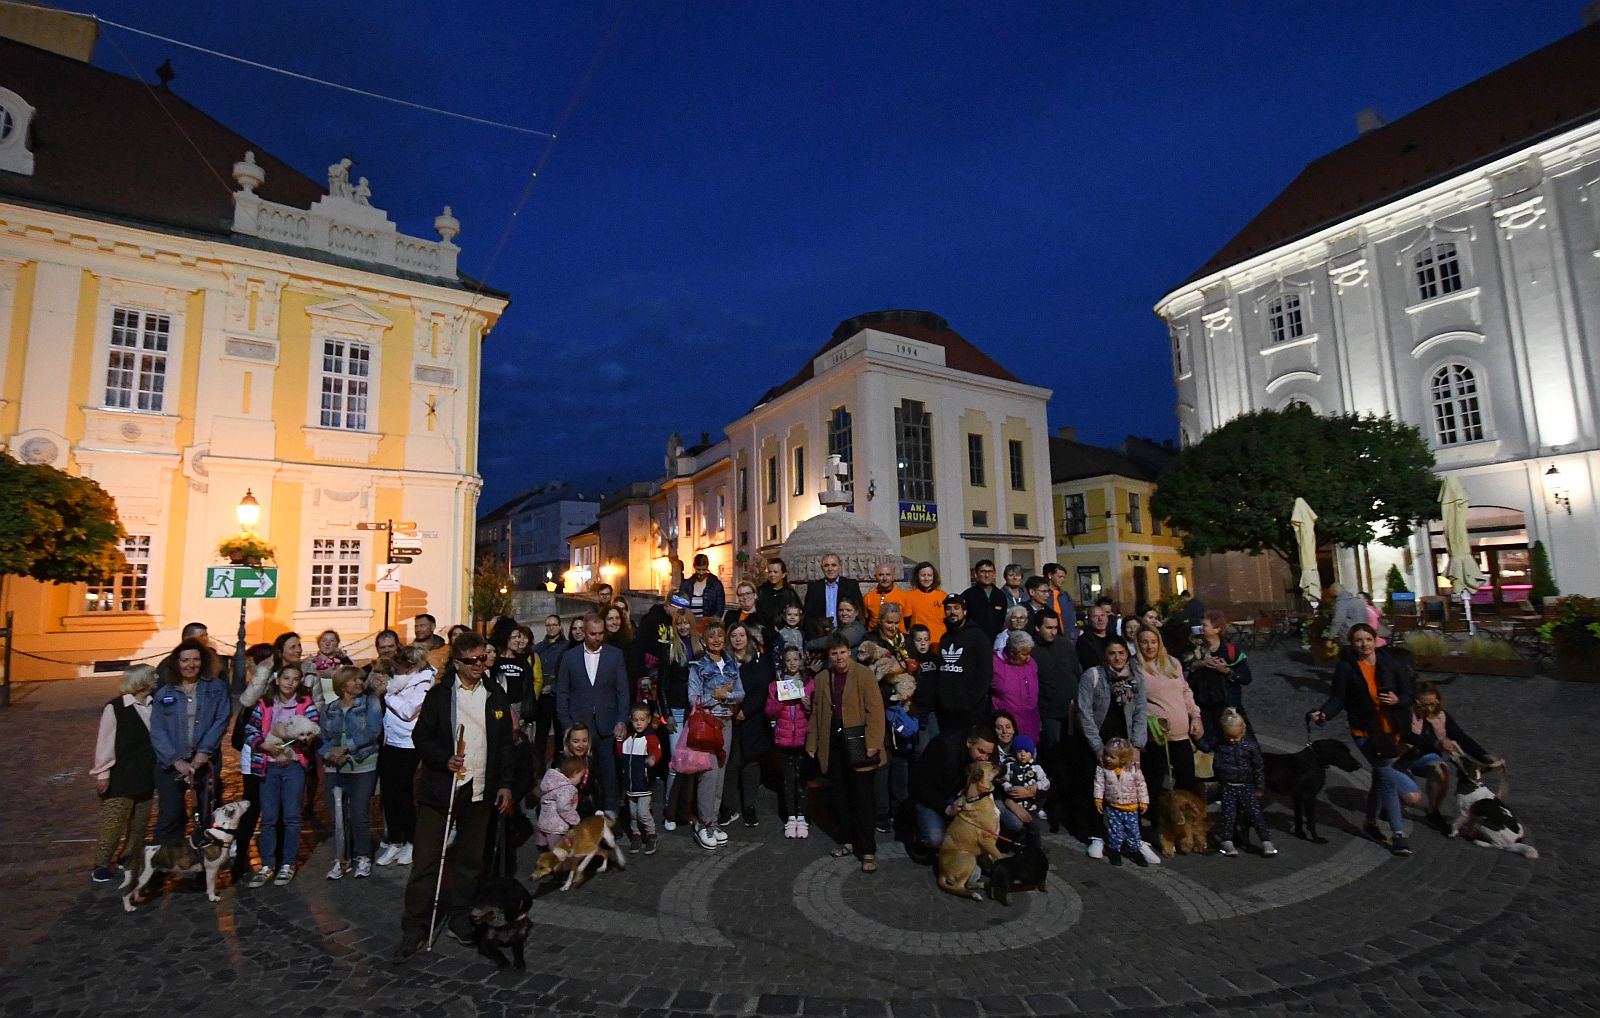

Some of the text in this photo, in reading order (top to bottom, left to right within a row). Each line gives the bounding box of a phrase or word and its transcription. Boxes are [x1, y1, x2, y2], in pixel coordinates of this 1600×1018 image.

[896, 344, 918, 357] 1994
[901, 509, 937, 522] ÁRUHÁZ
[940, 663, 964, 673] adidas
